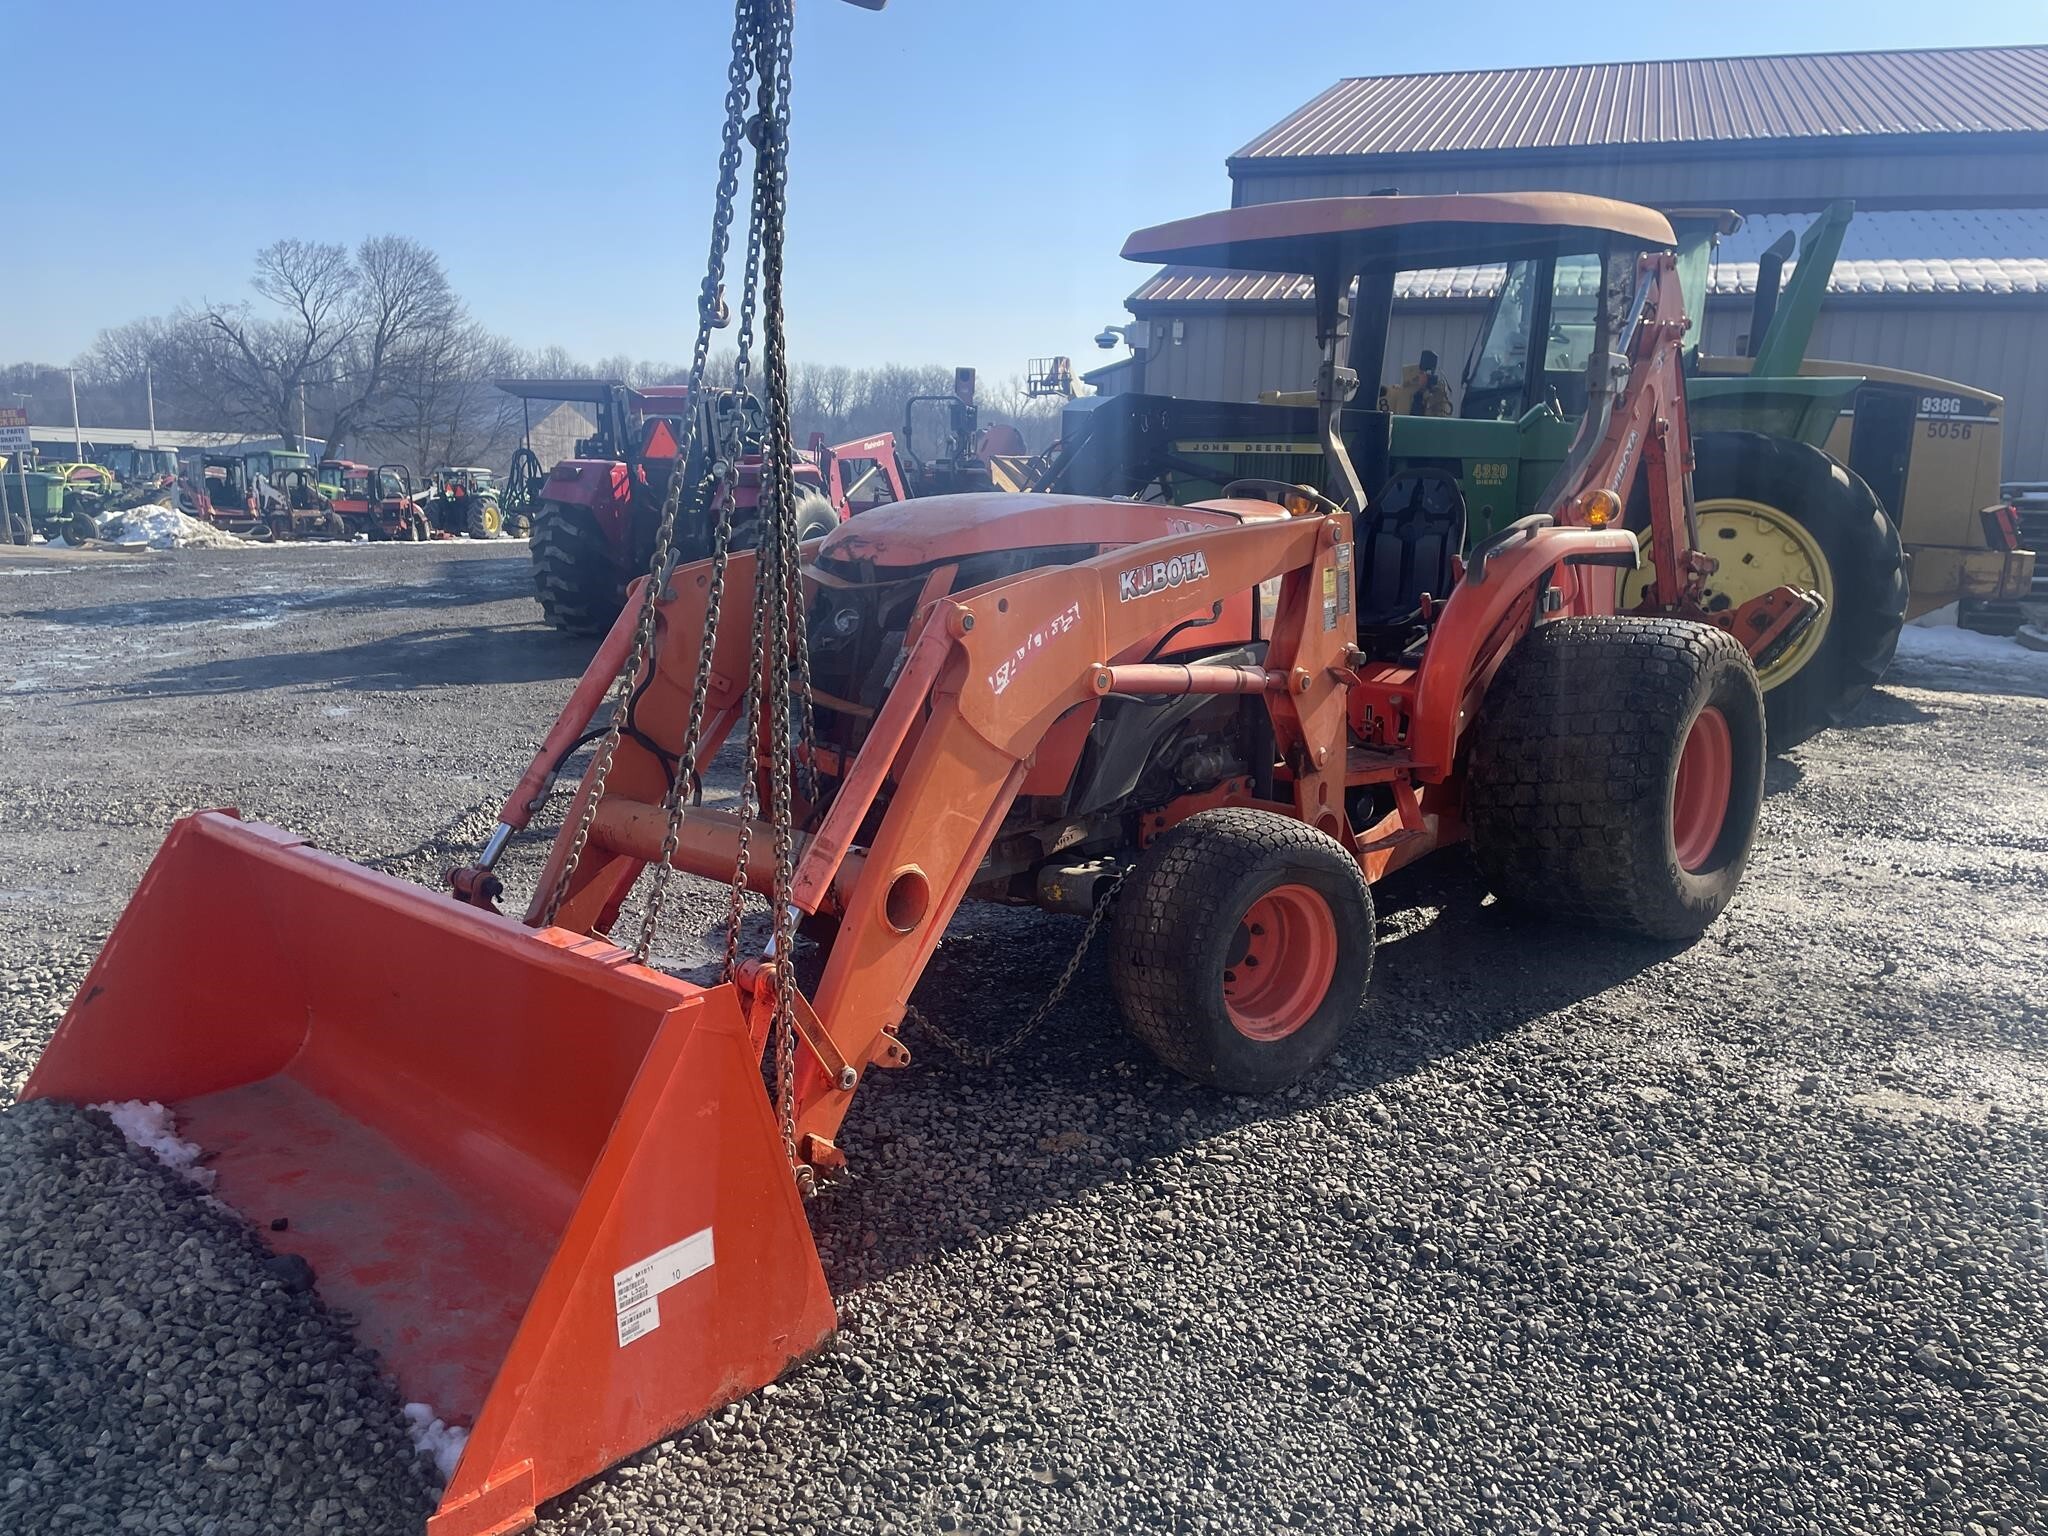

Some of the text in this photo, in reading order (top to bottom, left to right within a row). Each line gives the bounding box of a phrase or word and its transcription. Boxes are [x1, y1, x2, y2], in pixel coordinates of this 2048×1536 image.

[1922, 397, 1960, 413] 938G
[1927, 423, 1972, 440] 5056
[1245, 444, 1293, 452] DEERE
[1472, 463, 1508, 479] 4320
[1119, 551, 1209, 603] KUBOTA
